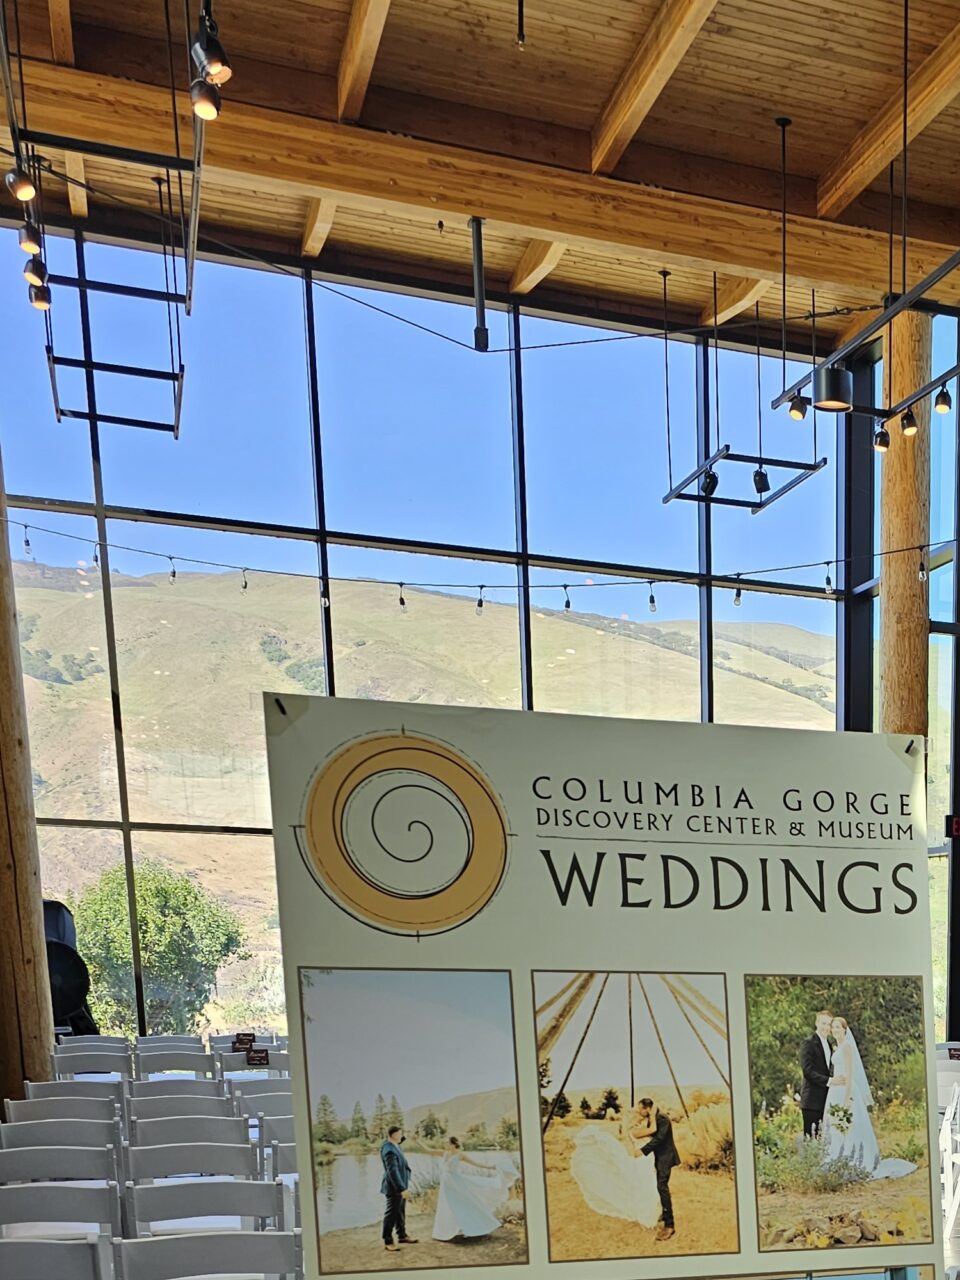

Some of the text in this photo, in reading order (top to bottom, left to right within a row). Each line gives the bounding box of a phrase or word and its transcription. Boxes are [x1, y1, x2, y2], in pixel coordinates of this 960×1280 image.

[532, 776, 912, 816] COLUMBIA GORGE
[536, 807, 914, 841] DISCOVERY CENTER & MUSEUM
[540, 849, 918, 915] WEDDINGS
